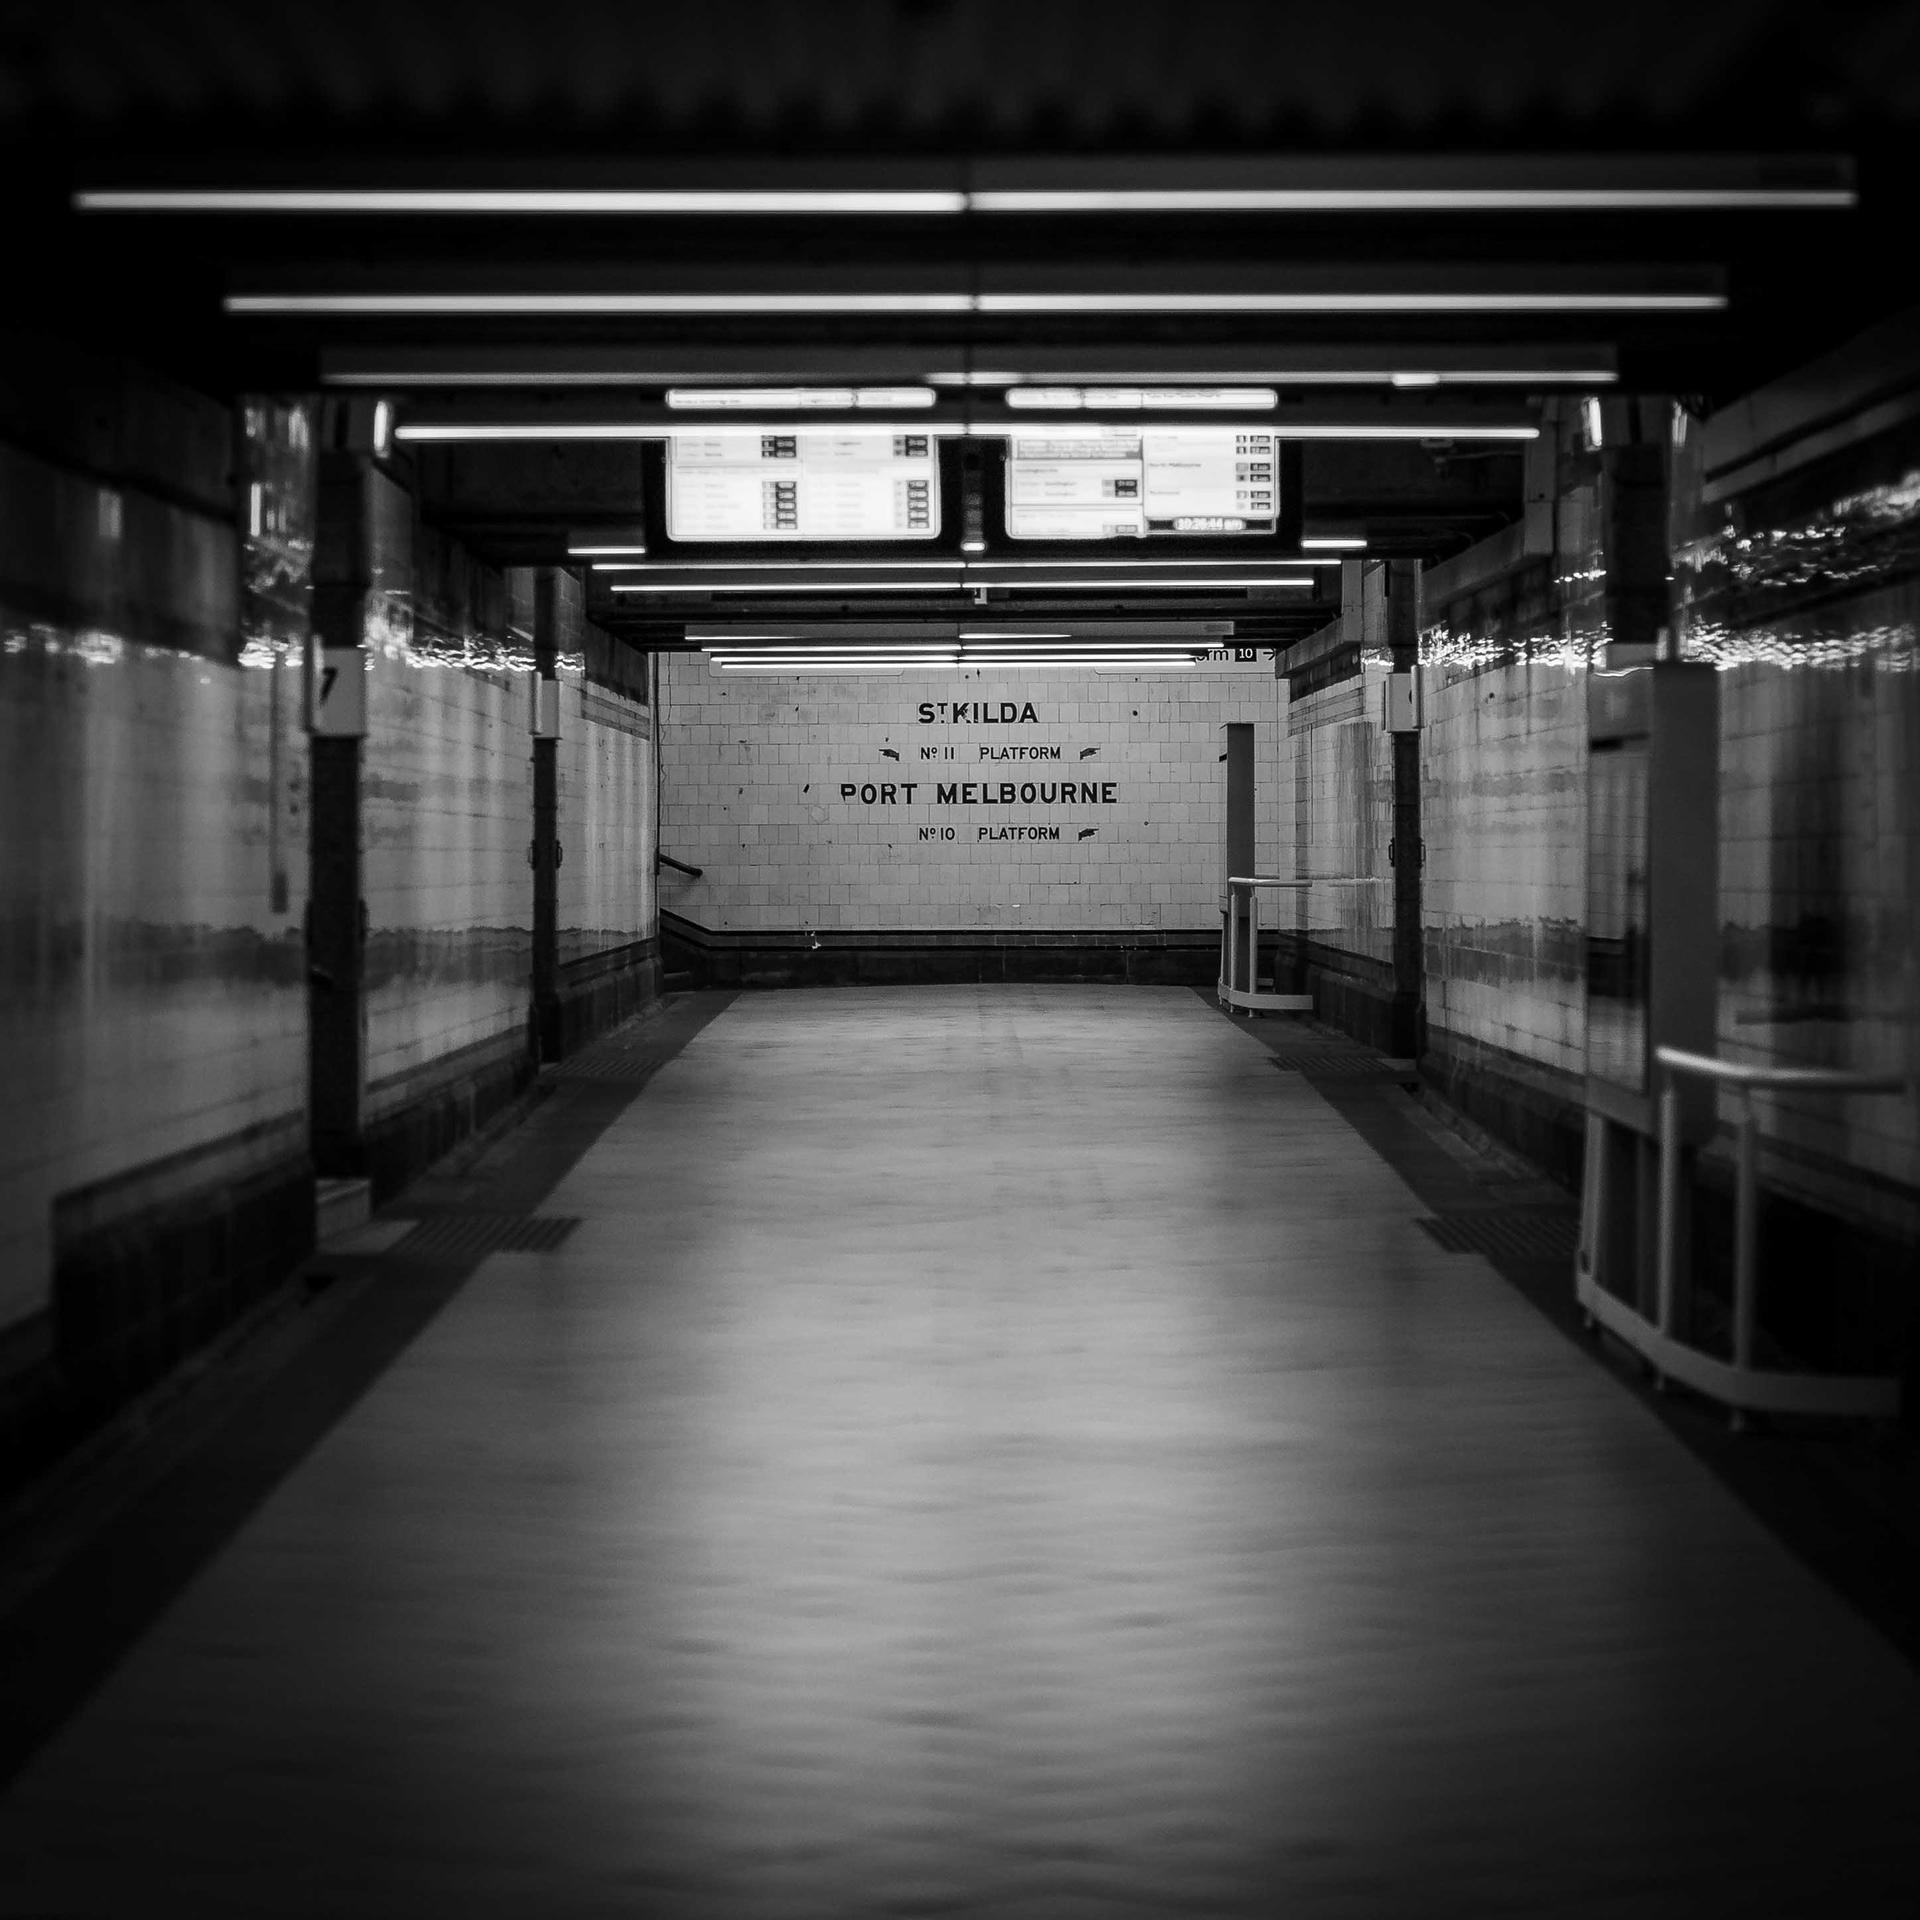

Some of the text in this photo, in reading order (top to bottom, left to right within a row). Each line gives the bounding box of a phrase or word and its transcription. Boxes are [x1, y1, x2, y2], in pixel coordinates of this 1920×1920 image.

[1239, 648, 1254, 659] 10
[952, 702, 1039, 724] KILDA
[979, 746, 1061, 760] PLATFORM
[840, 782, 1118, 805] PORT MELBOURNE
[977, 826, 1060, 842] PLATFORM
